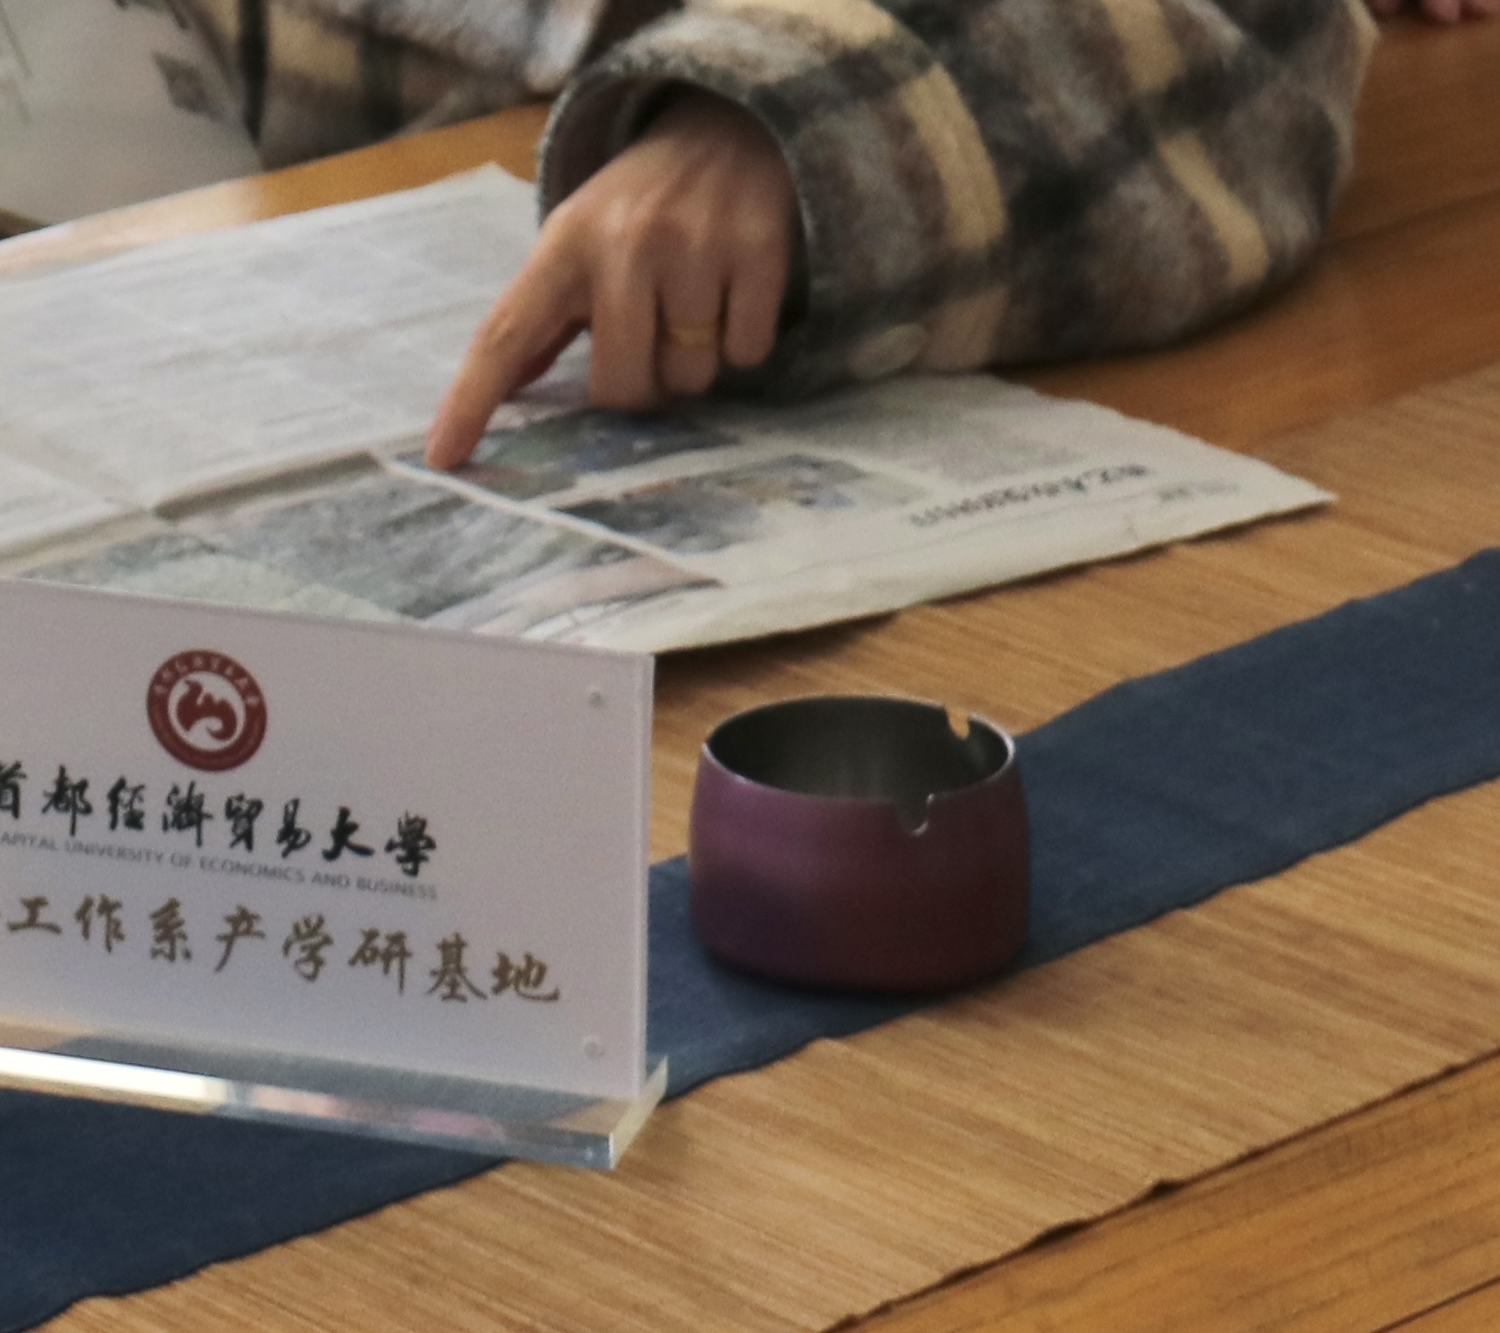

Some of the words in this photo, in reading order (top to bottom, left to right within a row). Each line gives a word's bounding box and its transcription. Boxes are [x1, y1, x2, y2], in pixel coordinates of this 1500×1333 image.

[64, 840, 164, 865] UNIVERSITY
[170, 851, 195, 869] OF
[198, 856, 306, 884] ECONOMICS
[310, 871, 352, 889] AND
[356, 876, 438, 900] BUSINESS
